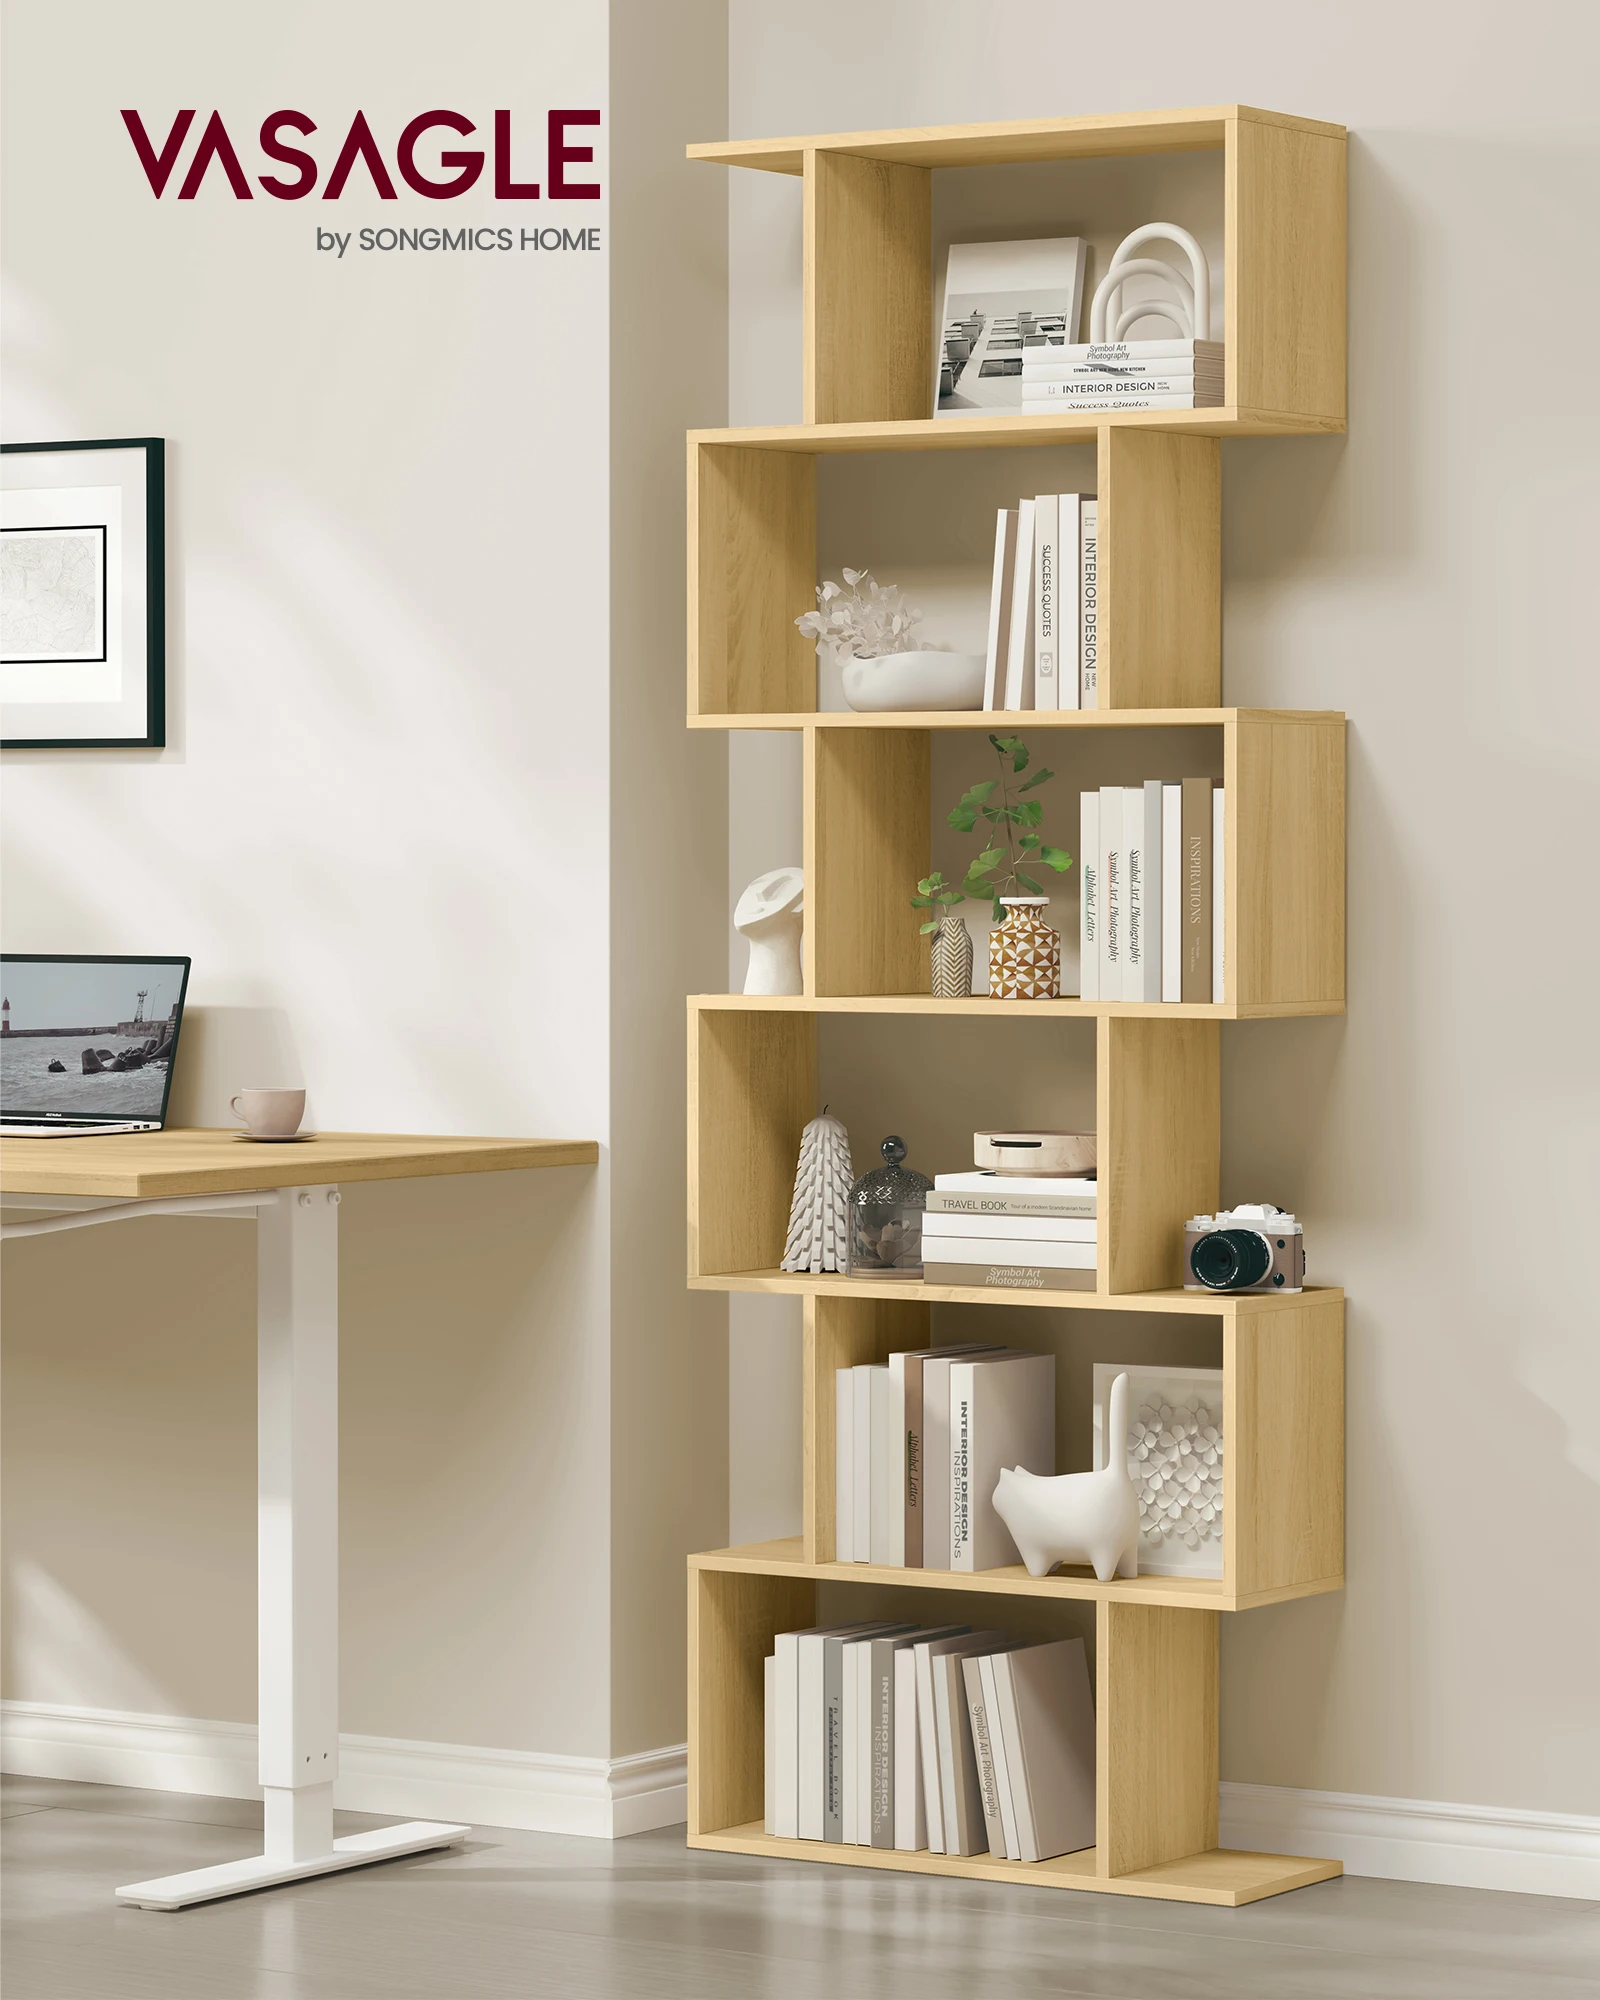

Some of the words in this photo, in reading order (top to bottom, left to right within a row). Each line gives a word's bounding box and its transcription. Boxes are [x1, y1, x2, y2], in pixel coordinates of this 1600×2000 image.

[1086, 351, 1130, 360] Photography
[1089, 344, 1115, 353] Symbol
[1062, 383, 1113, 394] INTERIOR
[1116, 382, 1155, 392] DESIGN
[1112, 400, 1150, 408] Quotes
[1042, 544, 1052, 591] SUCCESS
[1085, 538, 1097, 609] INTERIOR
[1041, 594, 1052, 637] QUOTES
[1085, 614, 1097, 670] DESIGN
[1108, 851, 1119, 884] Symbol
[1130, 849, 1141, 883] Symbol
[1190, 836, 1201, 924] INSPIRATIONS
[1086, 865, 1096, 907] Alphabet
[1110, 885, 1118, 901] Art
[1131, 884, 1140, 901] Art
[1087, 911, 1096, 942] Letters
[1108, 906, 1119, 962] Photography
[1130, 906, 1141, 964] Photography
[942, 1199, 979, 1210] TRAVEL
[980, 1201, 1008, 1211] BOOK
[985, 1275, 1045, 1288] Photography
[990, 1267, 1025, 1278] Symbol
[1026, 1269, 1041, 1278] Art
[909, 1431, 919, 1473] Alphabet
[909, 1475, 919, 1507] Letters
[881, 1676, 889, 1753] INTERIOR
[972, 1706, 988, 1740] Symbol
[979, 1741, 989, 1756] Art
[874, 1726, 882, 1834] INSPIRATIONS
[982, 1760, 998, 1818] Photography
